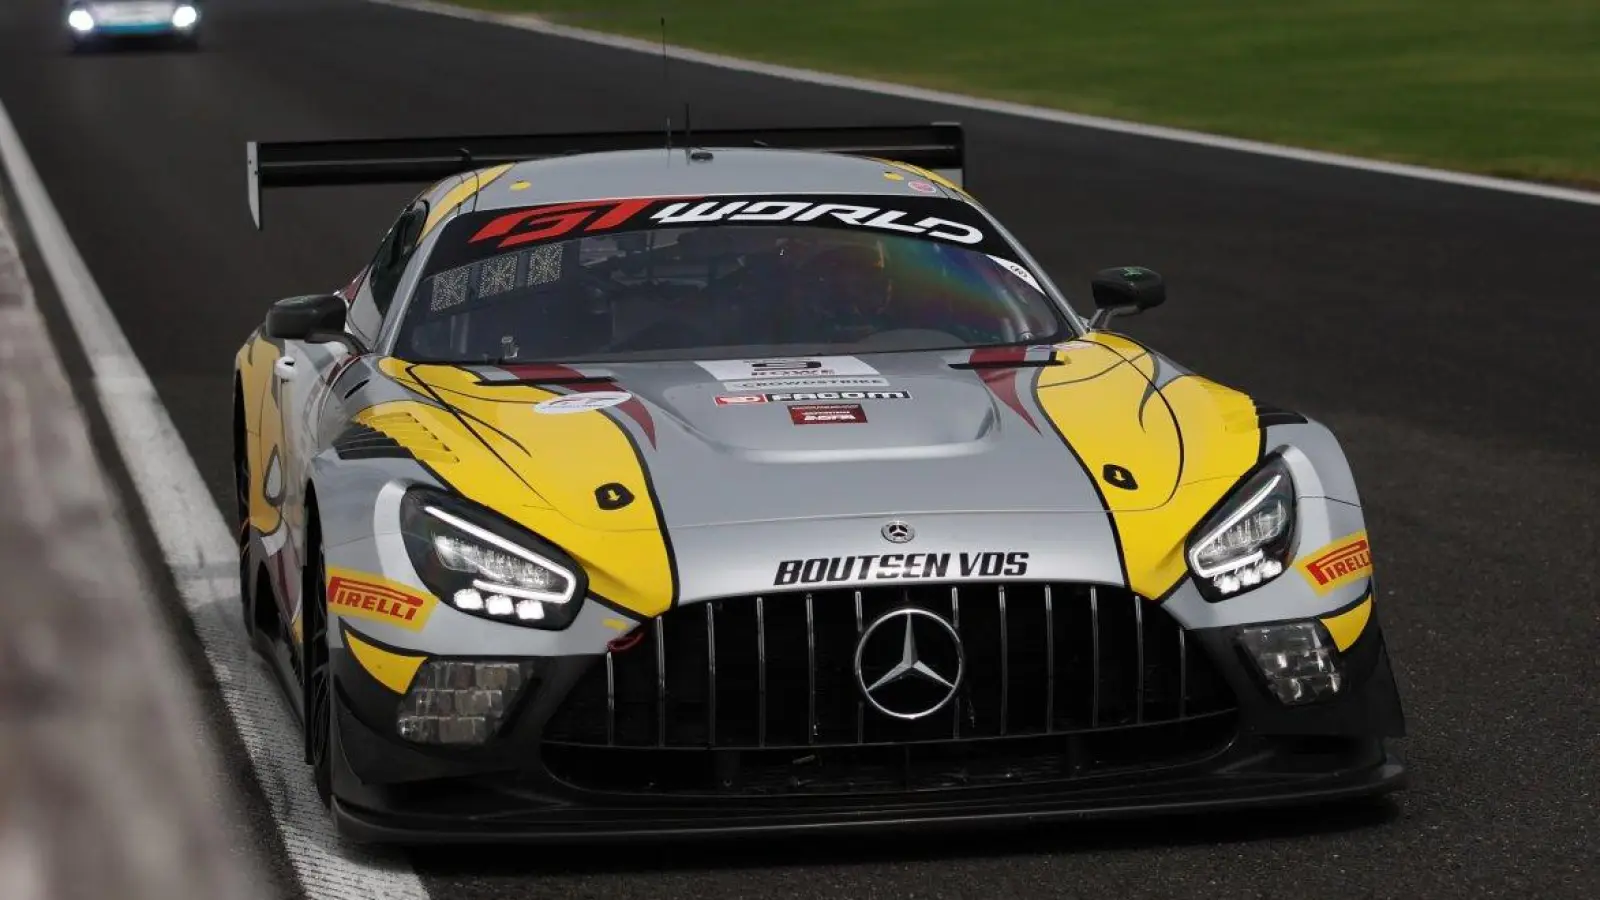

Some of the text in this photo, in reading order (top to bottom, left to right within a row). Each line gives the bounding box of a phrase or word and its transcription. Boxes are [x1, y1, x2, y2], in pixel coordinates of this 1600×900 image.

[468, 199, 983, 248] GT WORLD
[774, 551, 1029, 586] BOUTSEN VDS
[327, 576, 424, 621] PIRELLI
